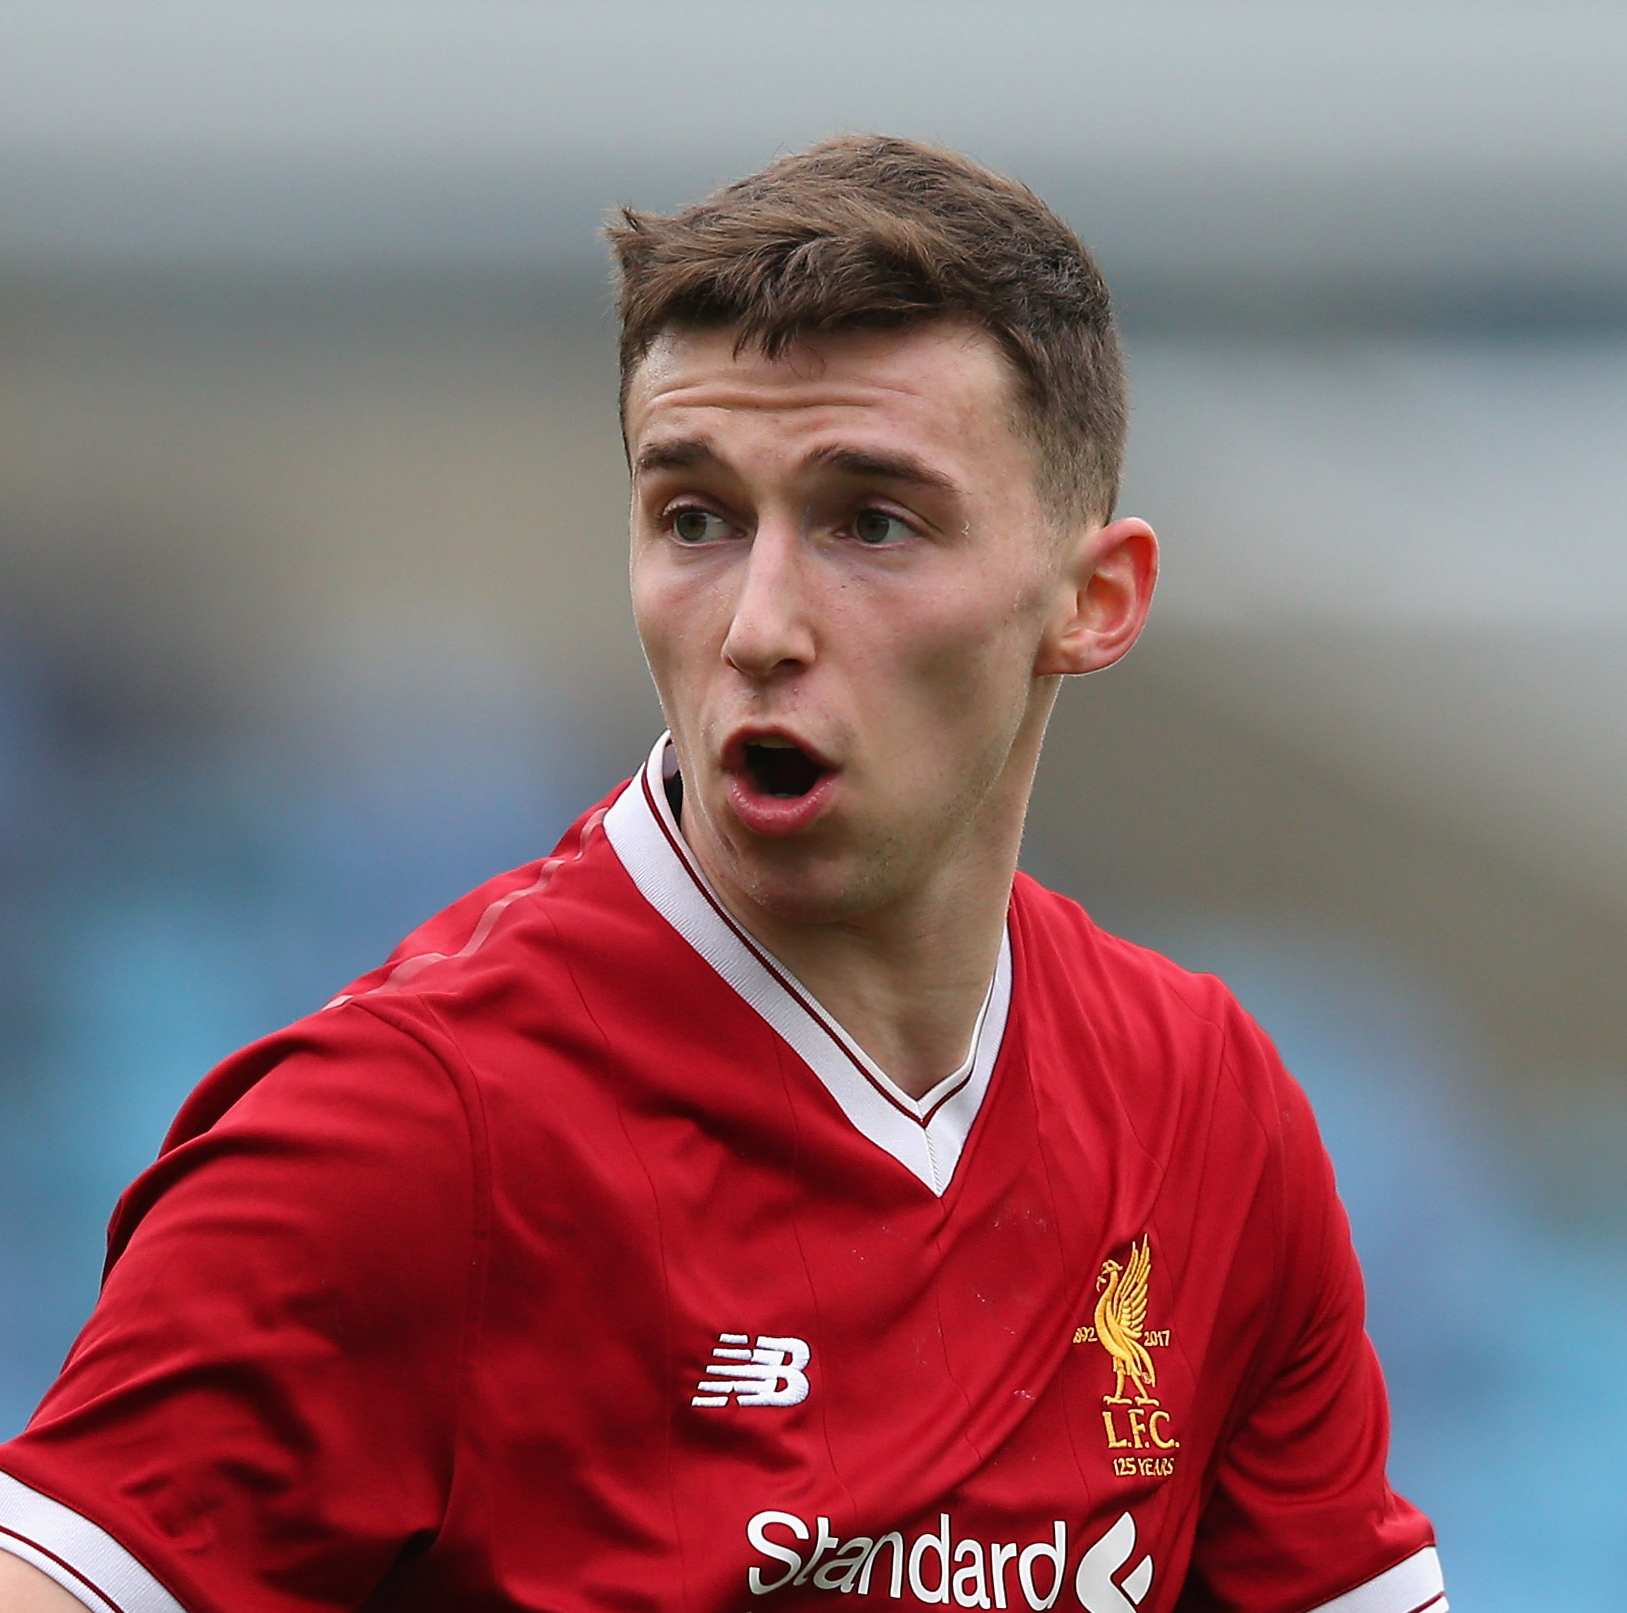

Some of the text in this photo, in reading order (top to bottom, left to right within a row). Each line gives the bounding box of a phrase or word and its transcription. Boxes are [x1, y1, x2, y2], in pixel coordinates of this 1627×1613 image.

[1144, 1330, 1170, 1346] 2017
[1102, 1409, 1180, 1449] L.F.C.
[1113, 1457, 1174, 1477] 125 YEARS
[746, 1510, 1067, 1611] Standard
